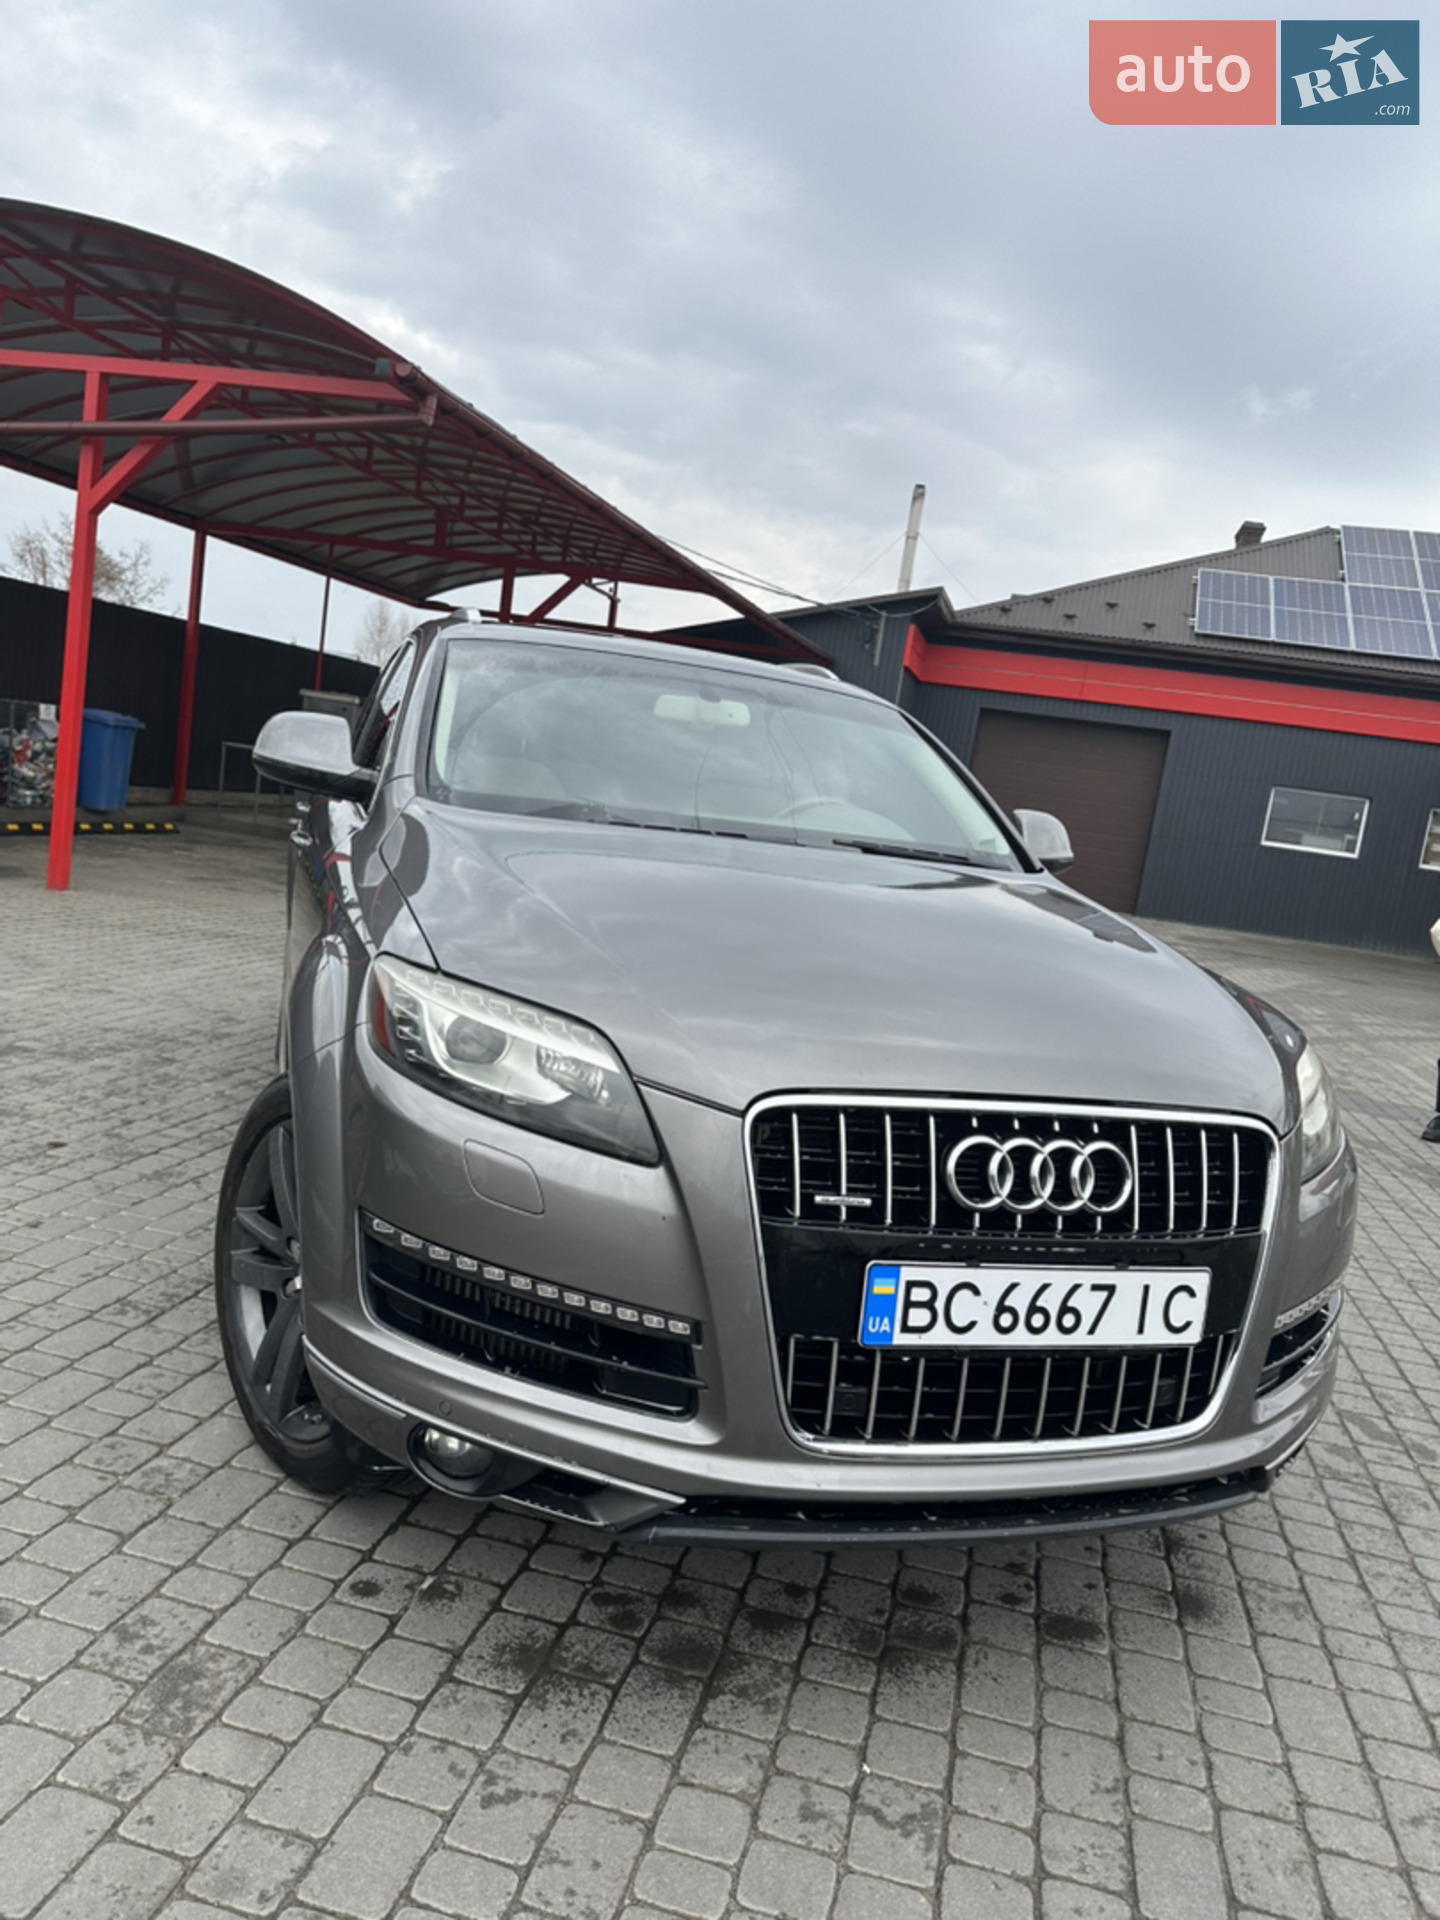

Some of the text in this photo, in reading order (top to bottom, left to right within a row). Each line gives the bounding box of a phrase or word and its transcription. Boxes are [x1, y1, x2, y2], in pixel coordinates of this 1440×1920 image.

[867, 1316, 891, 1334] UA
[900, 1279, 1198, 1336] BC 6667 IC
